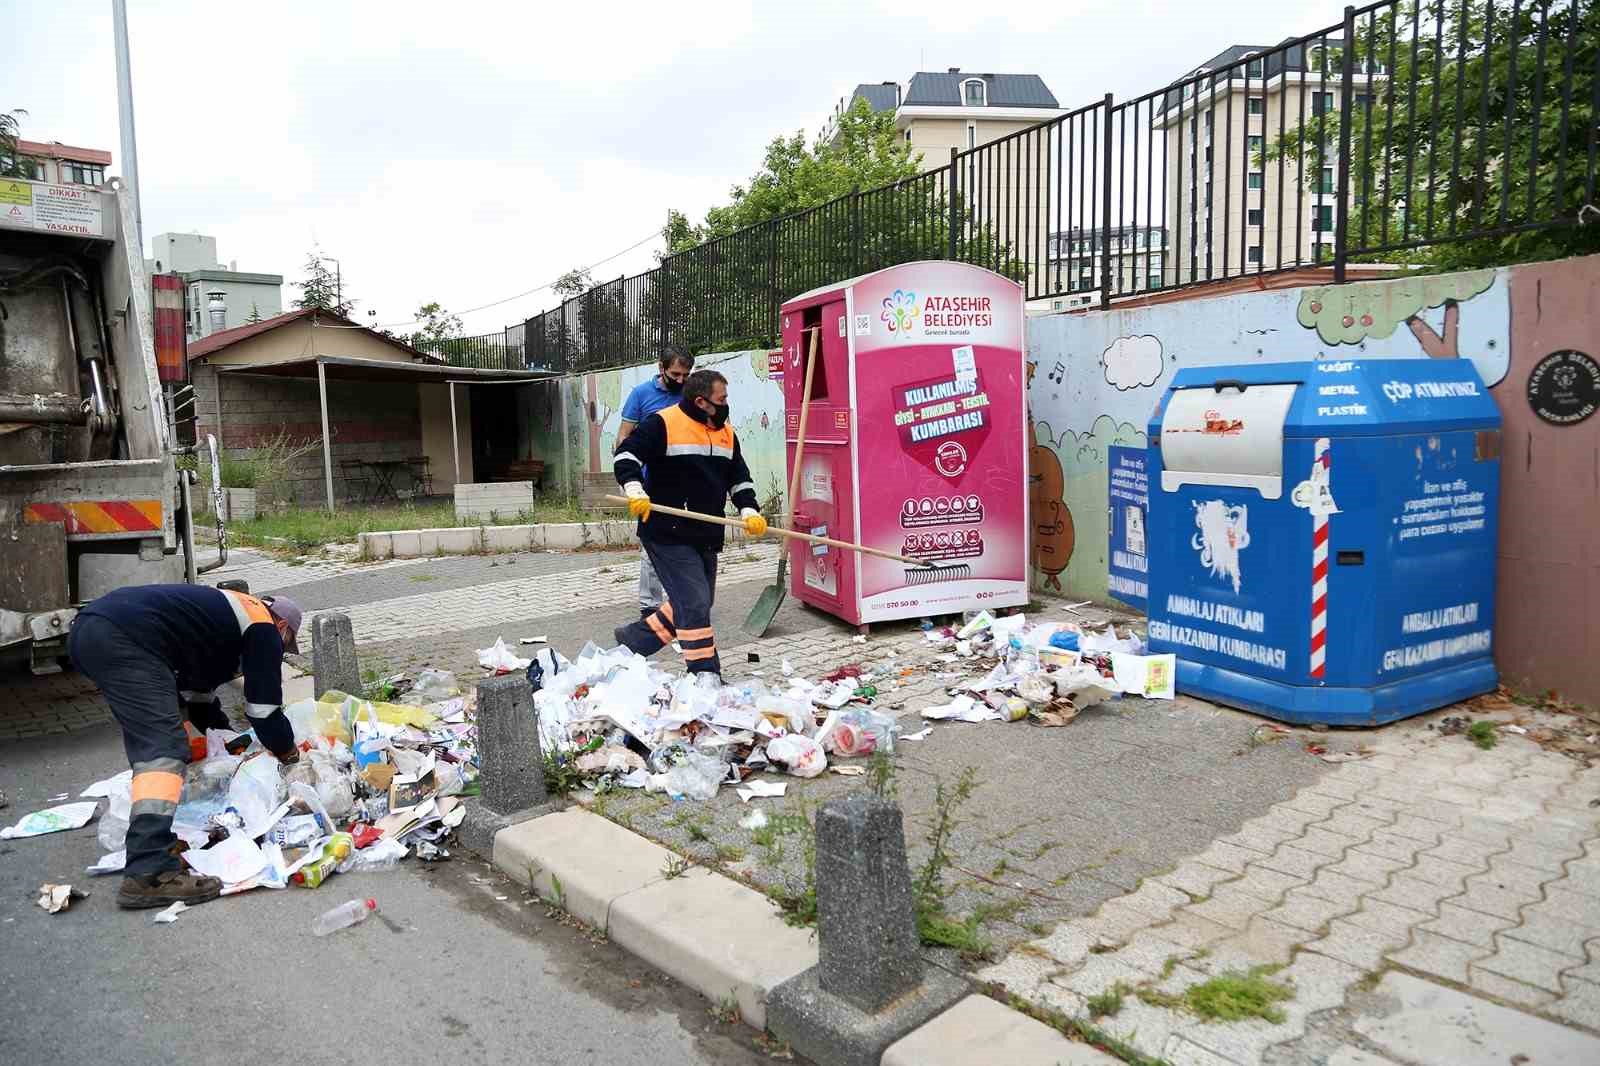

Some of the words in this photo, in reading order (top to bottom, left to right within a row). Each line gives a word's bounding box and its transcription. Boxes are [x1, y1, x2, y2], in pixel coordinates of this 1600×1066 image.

[904, 378, 977, 407] KULLANILMIŞ
[1319, 385, 1359, 396] METAL
[1382, 380, 1413, 404] ÇÖP
[1415, 381, 1480, 398] ATMAYINIZ
[1318, 402, 1367, 416] PLASTİK
[911, 411, 983, 442] KUMBARASI
[1167, 594, 1214, 621] AMBALAJ
[1215, 604, 1264, 633] ATIKLARI
[1148, 620, 1170, 641] GERİ
[1171, 625, 1217, 652] KAZANIM
[1219, 636, 1286, 670] KUMBARASI
